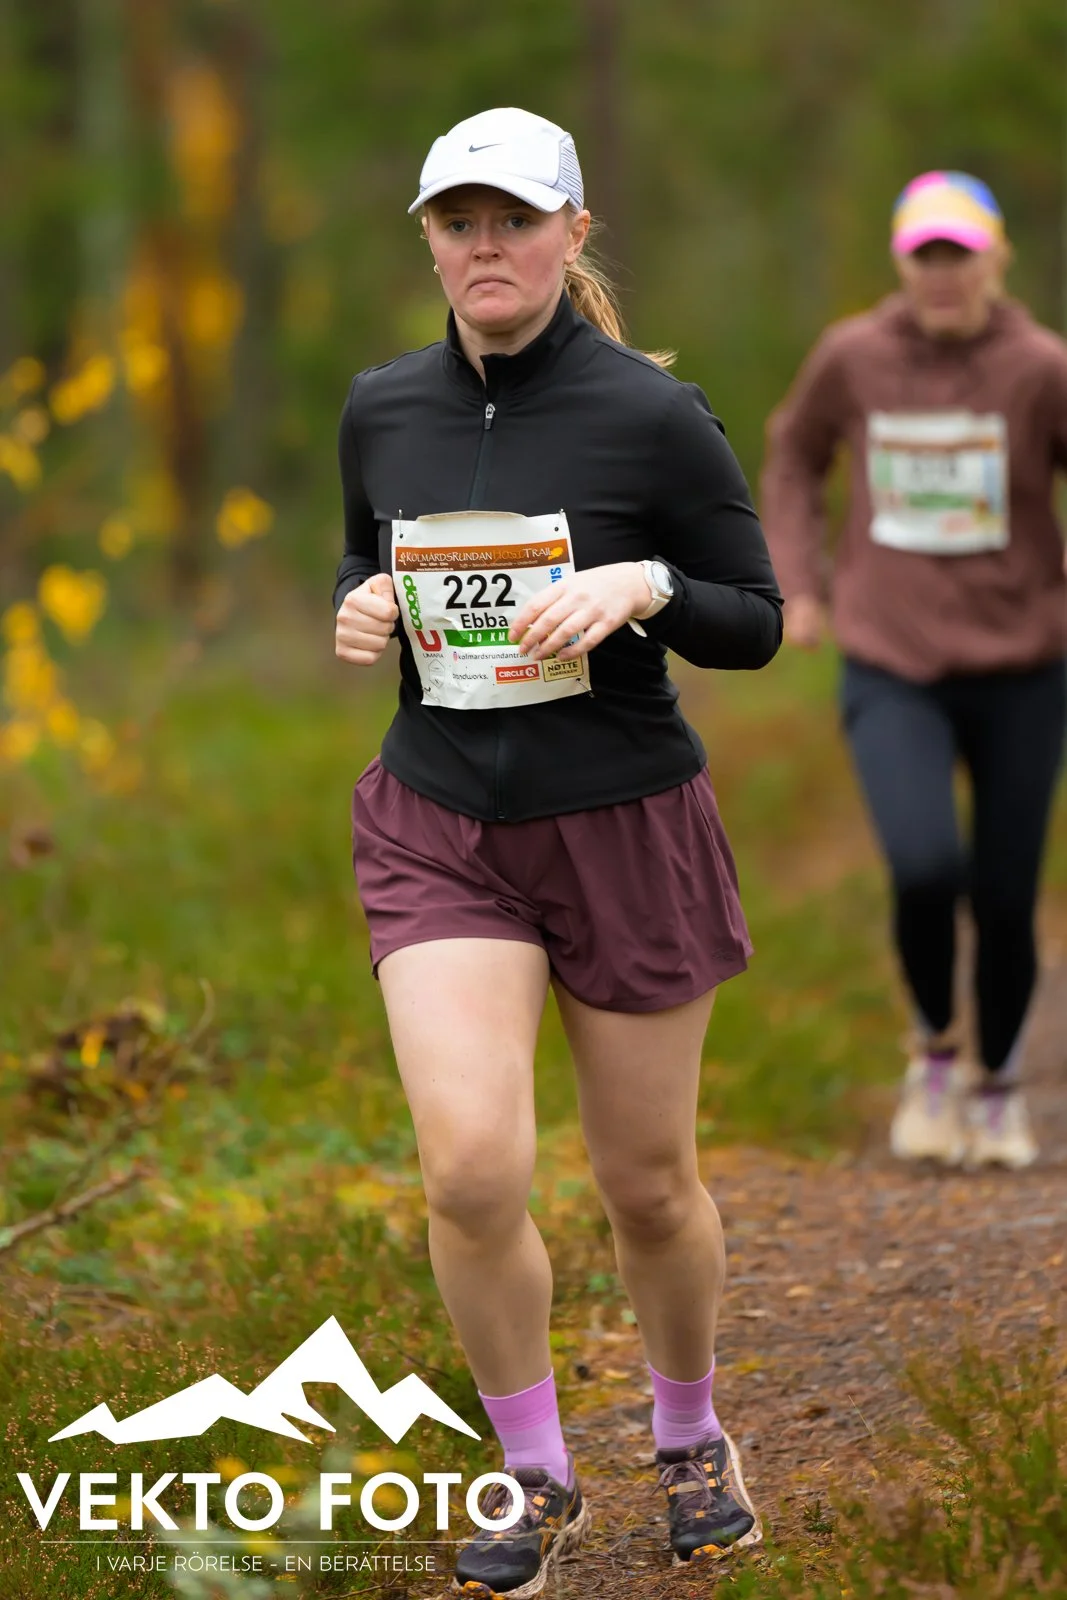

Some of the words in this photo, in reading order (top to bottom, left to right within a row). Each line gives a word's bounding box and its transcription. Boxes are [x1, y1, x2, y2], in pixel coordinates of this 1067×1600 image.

[550, 566, 562, 583] SI
[443, 573, 516, 610] 222
[403, 575, 423, 630] coop
[460, 612, 509, 629] Ebba
[468, 633, 483, 643] 10
[490, 631, 506, 642] KM
[498, 669, 525, 678] CIRCLE
